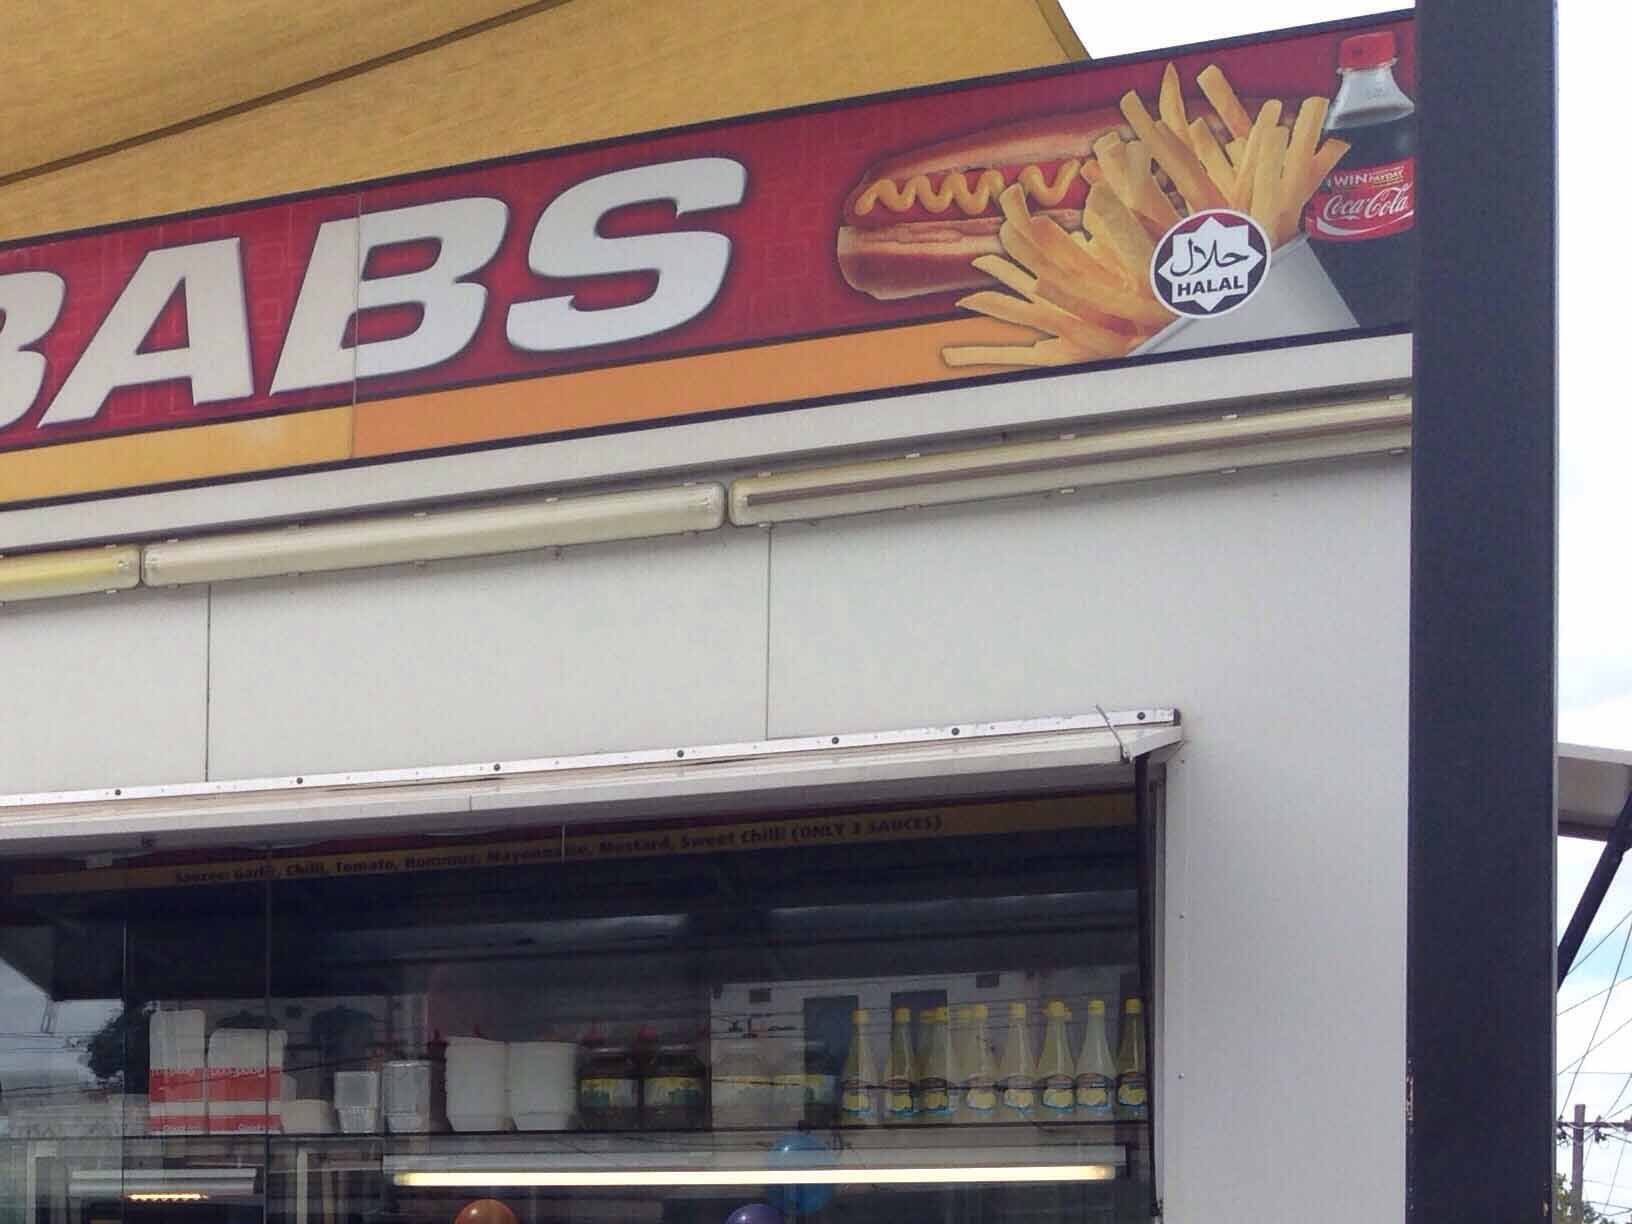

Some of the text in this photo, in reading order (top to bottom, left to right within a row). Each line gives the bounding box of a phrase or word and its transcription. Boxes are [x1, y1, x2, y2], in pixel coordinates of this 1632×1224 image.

[1323, 183, 1414, 221] Coca-Cola
[1169, 236, 1250, 278] حلال
[1176, 275, 1245, 297] HALAL
